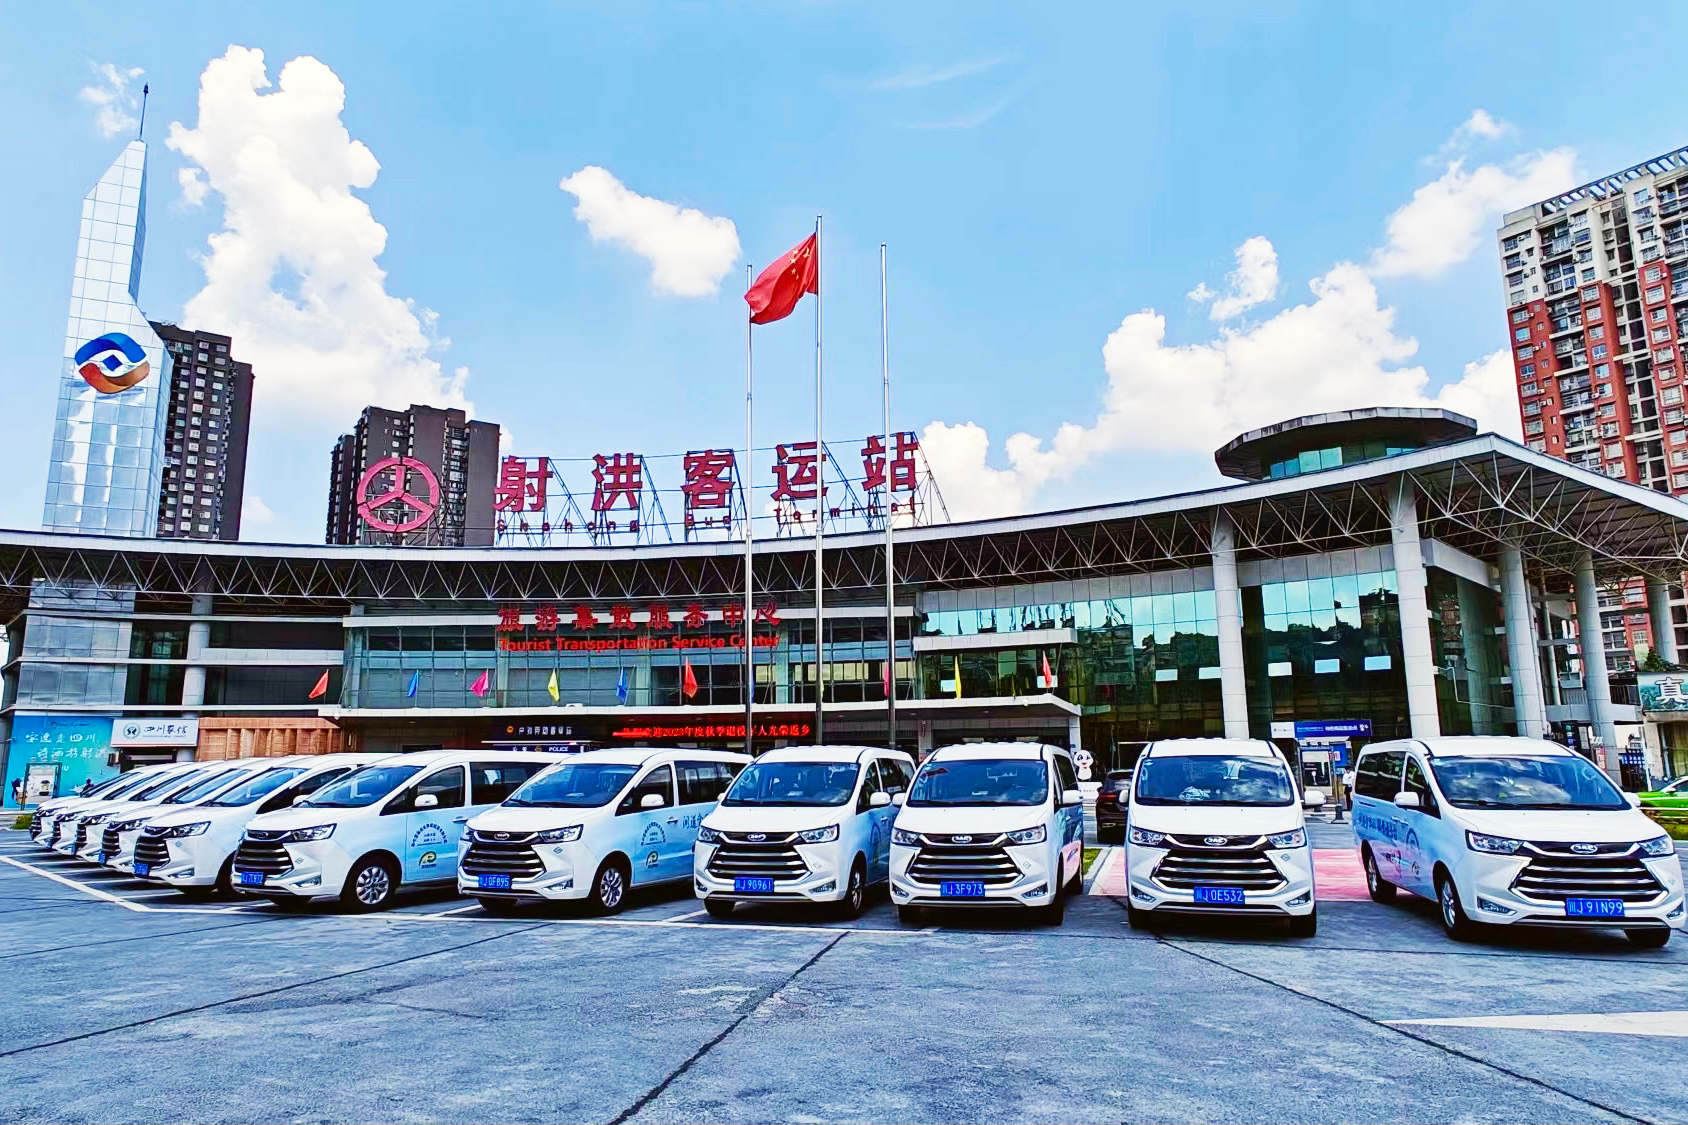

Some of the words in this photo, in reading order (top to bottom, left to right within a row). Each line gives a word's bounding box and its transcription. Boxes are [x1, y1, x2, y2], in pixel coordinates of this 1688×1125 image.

[493, 431, 920, 513] 射洪客运站
[494, 602, 782, 632] 旅游集散服务中心
[500, 636, 551, 651] Tourist
[556, 634, 668, 653] Transportation
[672, 634, 725, 649] Service
[1654, 677, 1688, 705] 真
